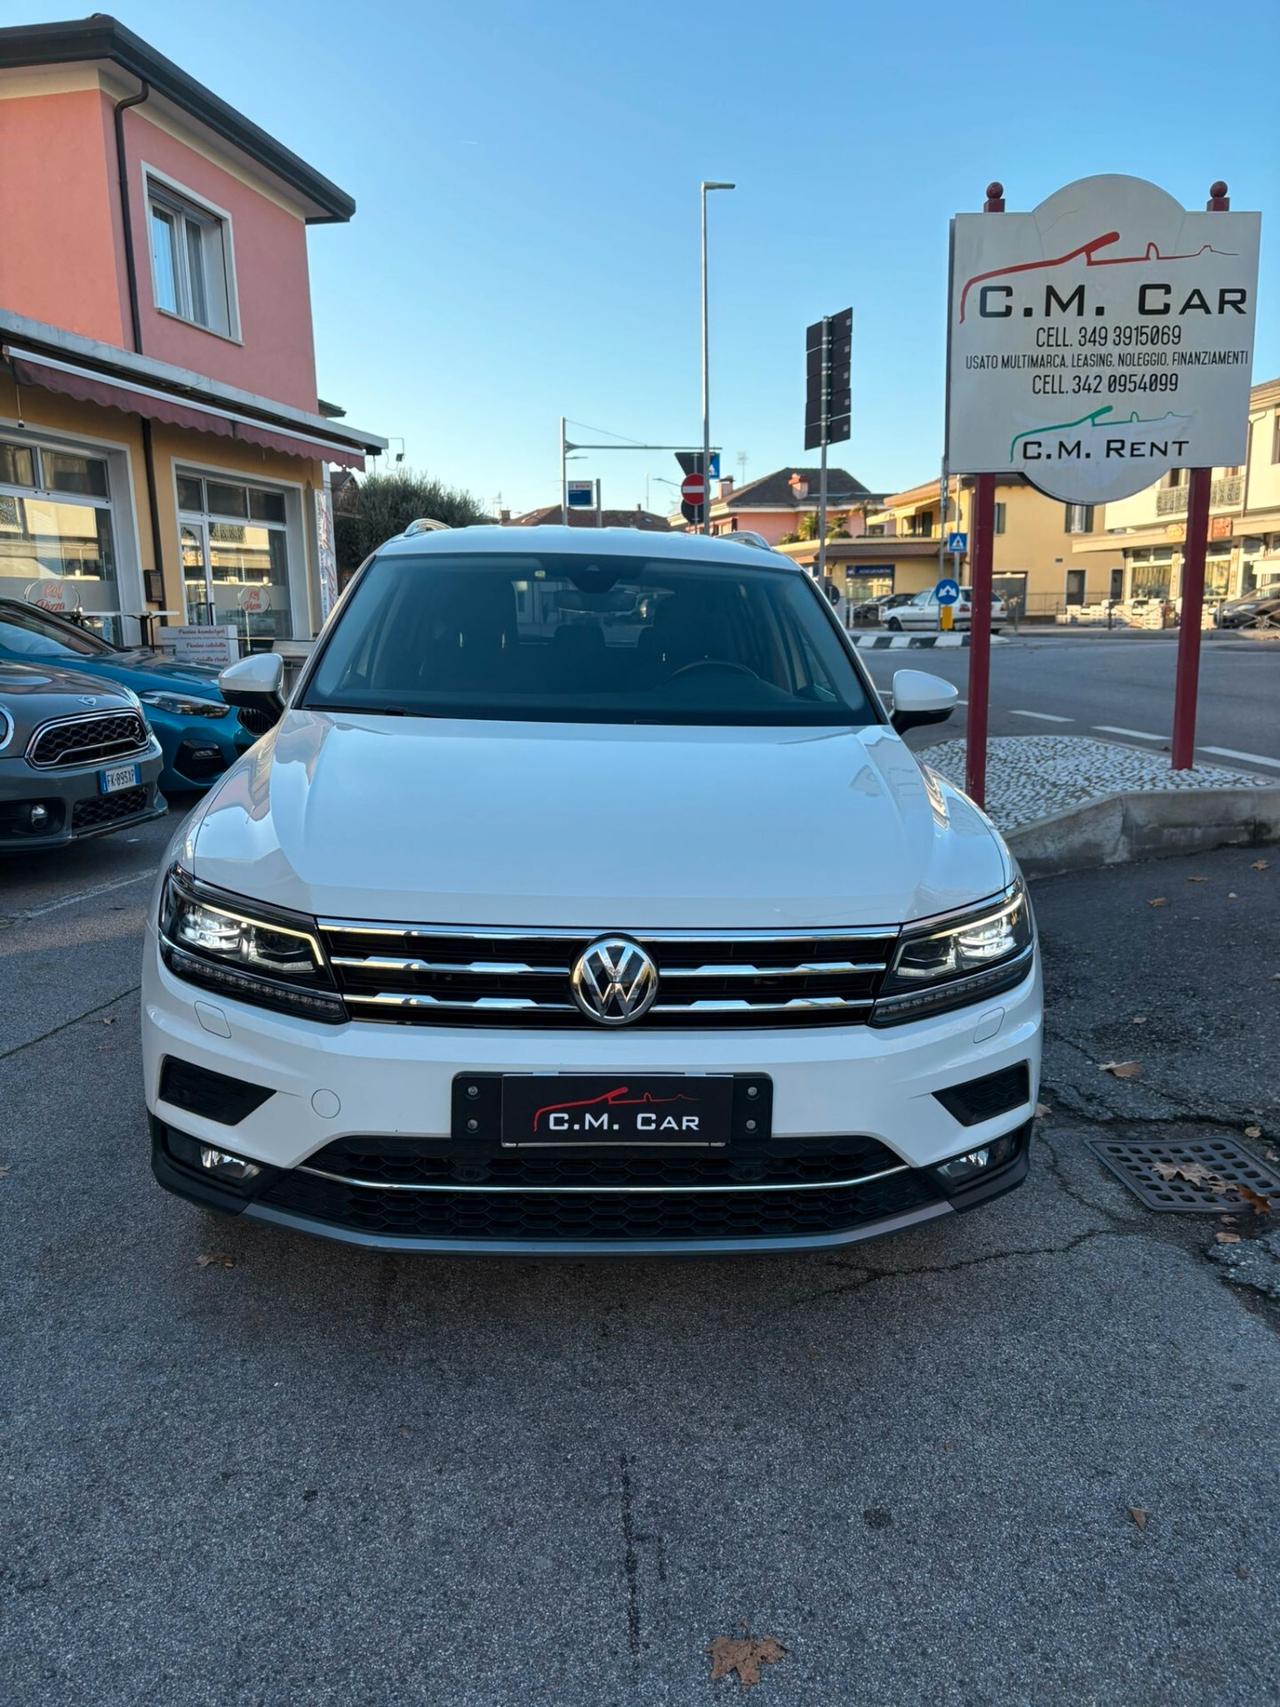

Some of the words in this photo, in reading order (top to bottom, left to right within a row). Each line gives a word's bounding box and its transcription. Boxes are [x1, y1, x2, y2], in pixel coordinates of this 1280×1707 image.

[979, 285, 1105, 318] C.M.
[1036, 326, 1073, 347] CELL.
[1079, 326, 1108, 347] 349
[1113, 324, 1181, 346] 3915069
[965, 354, 998, 369] USATO
[1172, 350, 1248, 366] FINANZIAMENTI
[1032, 374, 1069, 394] CELL.
[1072, 374, 1103, 394] 342
[1107, 373, 1179, 393] 0954099
[1022, 440, 1092, 460] C.M.
[549, 1113, 620, 1131] C.M.
